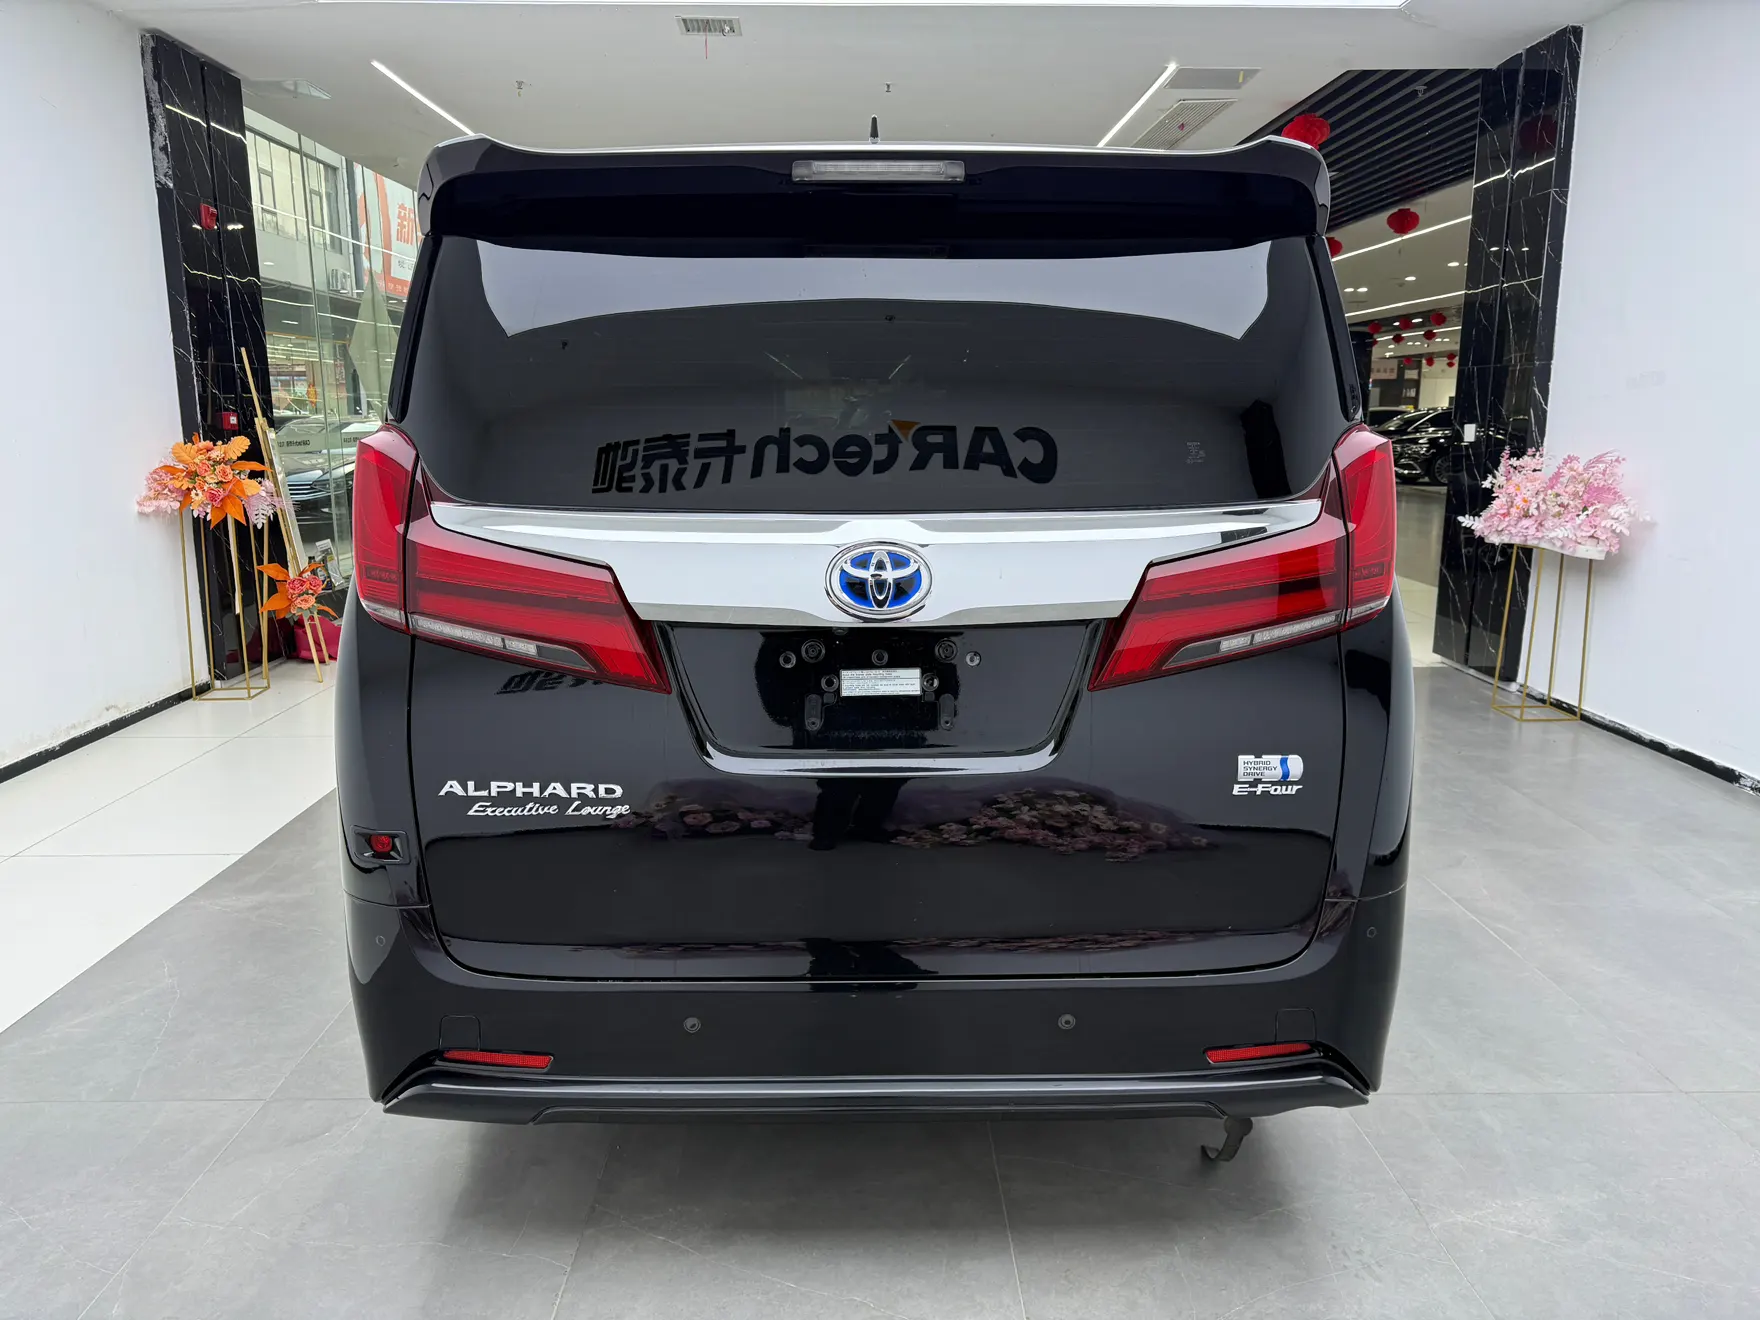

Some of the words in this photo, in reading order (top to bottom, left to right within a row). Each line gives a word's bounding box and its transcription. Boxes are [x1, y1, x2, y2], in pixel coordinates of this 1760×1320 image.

[438, 780, 624, 799] ALPHARD
[1232, 784, 1303, 796] E-Four
[466, 801, 559, 817] Executive
[565, 801, 631, 819] Lounge
